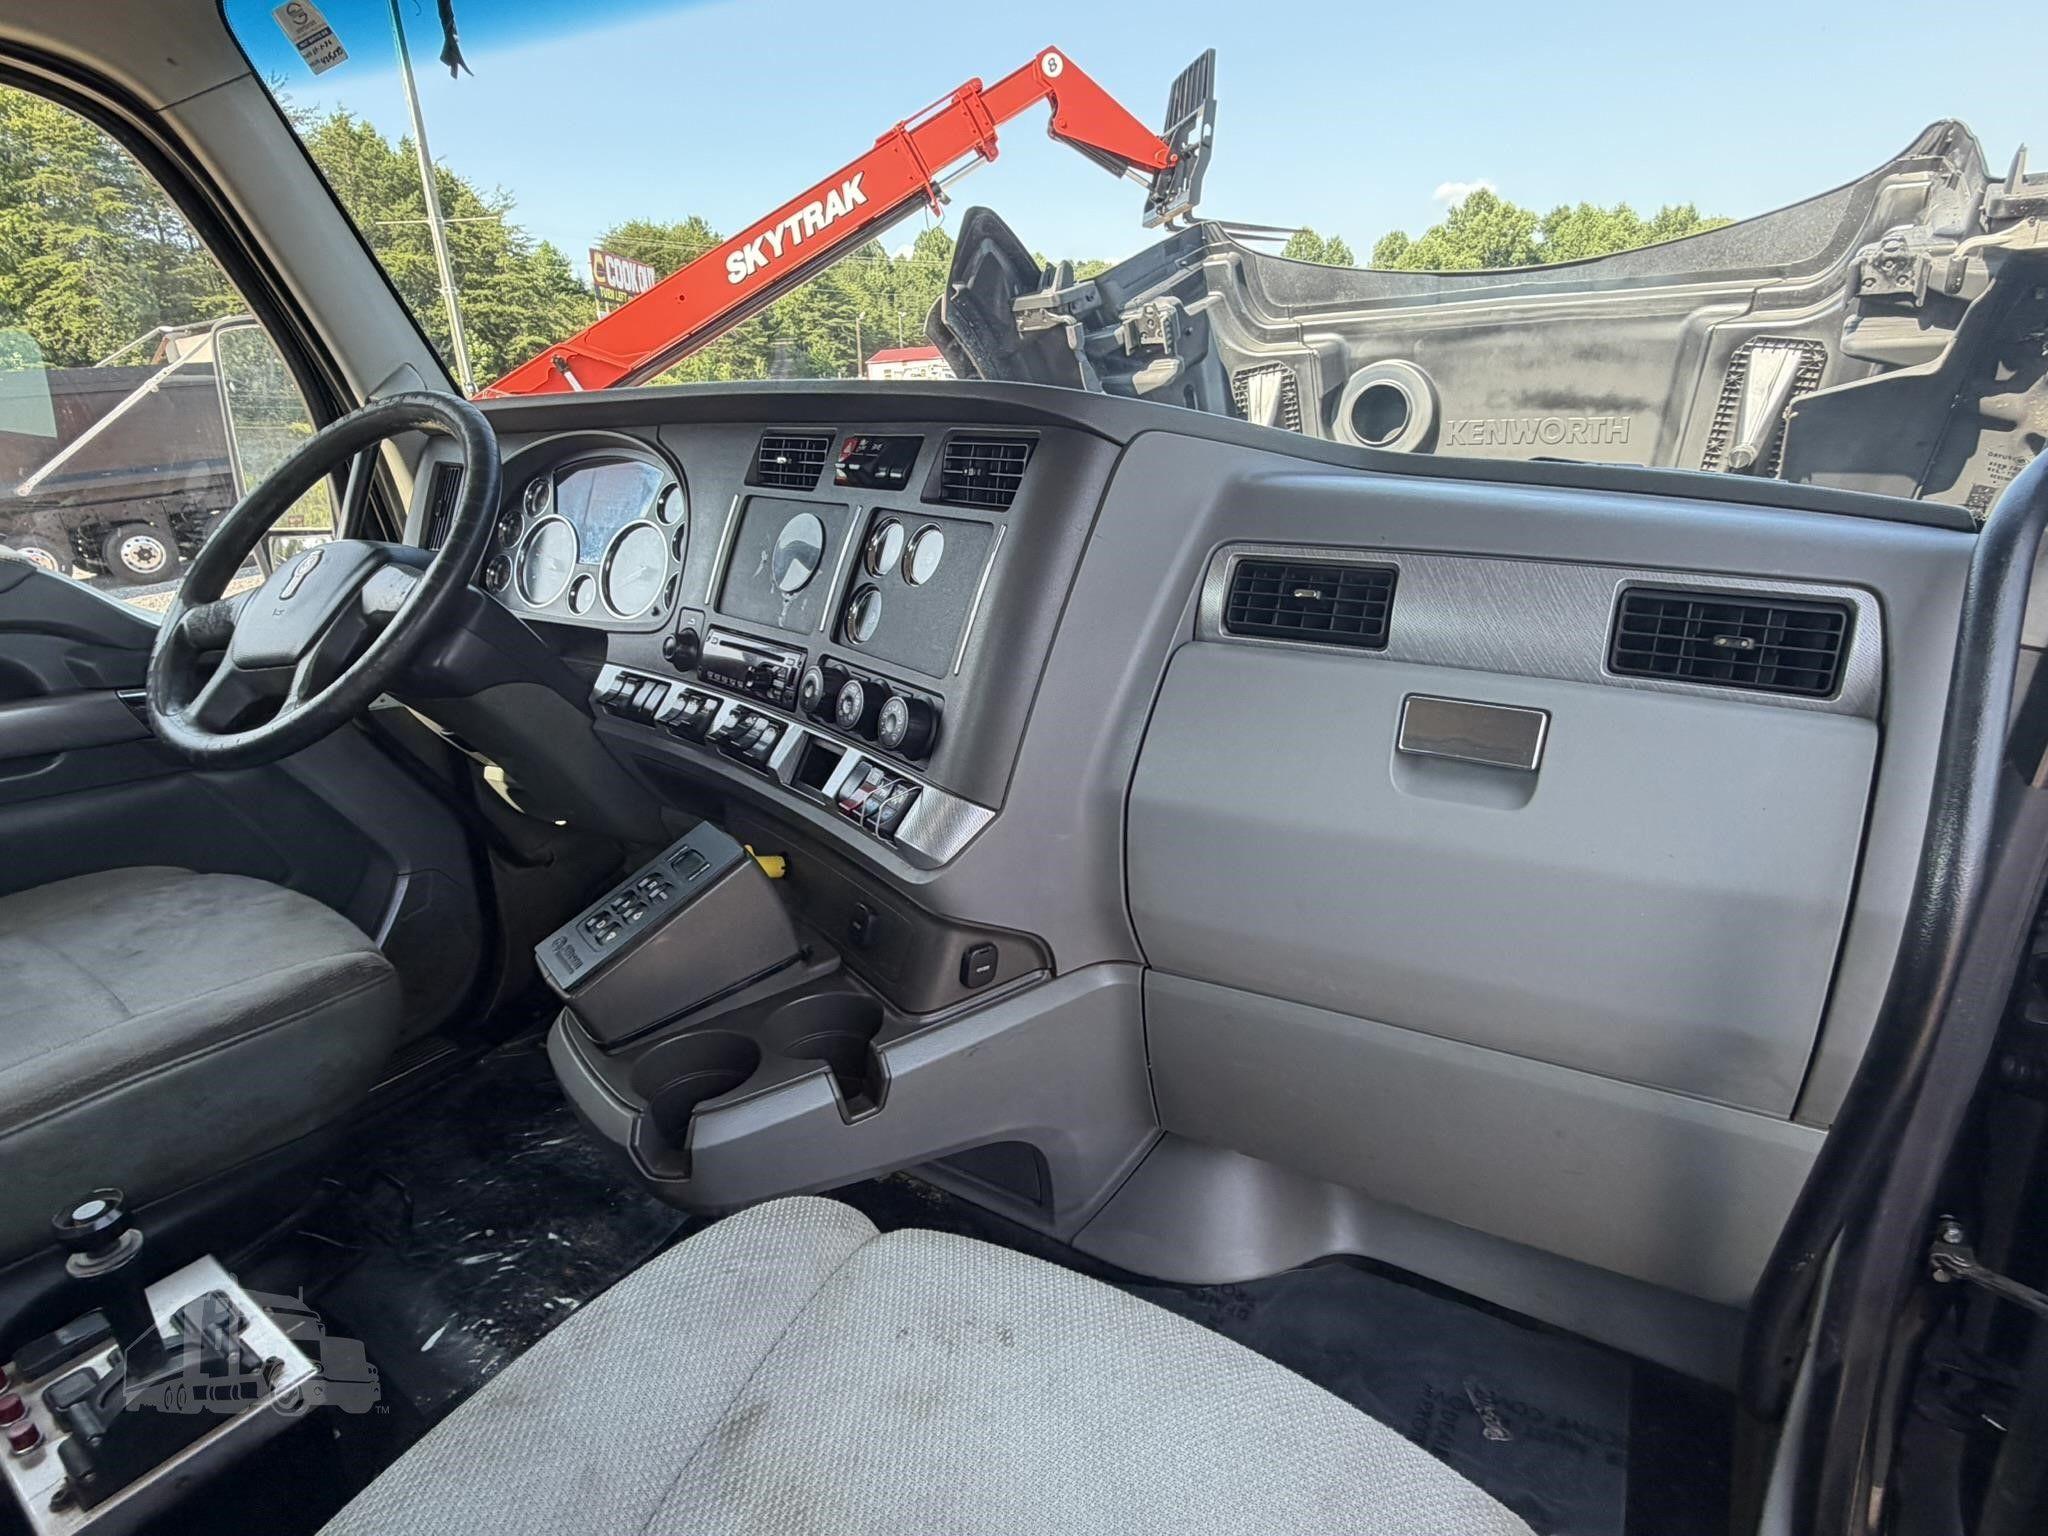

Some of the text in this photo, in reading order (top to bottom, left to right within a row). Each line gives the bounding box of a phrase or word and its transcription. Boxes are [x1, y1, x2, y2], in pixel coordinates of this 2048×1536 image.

[1047, 57, 1058, 73] 8
[725, 171, 869, 285] SKYTRAK
[605, 255, 640, 293] COOK
[1446, 416, 1631, 446] KENWORTH
